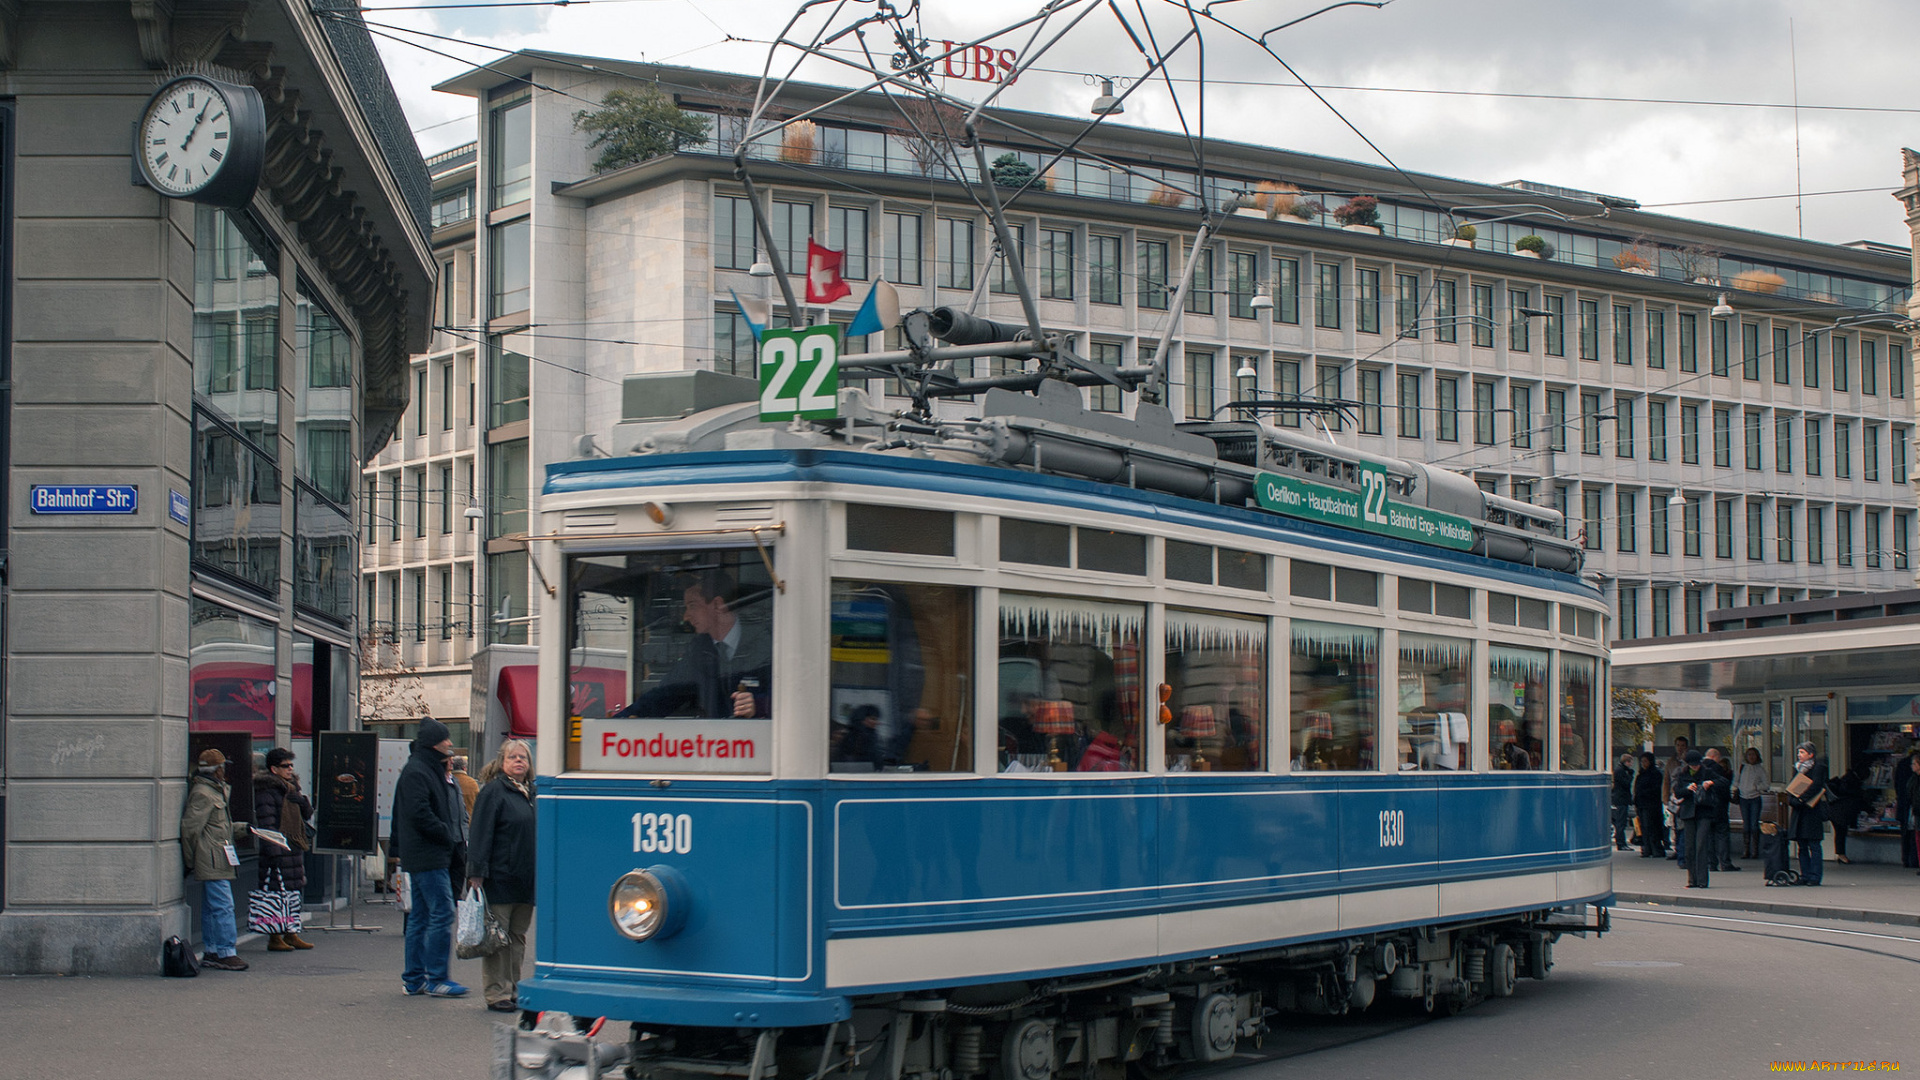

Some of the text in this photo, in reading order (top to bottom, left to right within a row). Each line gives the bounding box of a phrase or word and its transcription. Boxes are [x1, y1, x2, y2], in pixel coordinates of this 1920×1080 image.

[942, 40, 1019, 86] UBS
[761, 334, 836, 412] 22
[1267, 482, 1301, 506] Oerlikon
[1308, 491, 1358, 518] Hauptbahnhof
[1362, 469, 1387, 525] 22
[1390, 509, 1417, 530] Bahnhof
[602, 732, 754, 758] Fonduetram
[631, 812, 692, 854] 1330
[1379, 810, 1404, 847] 1330
